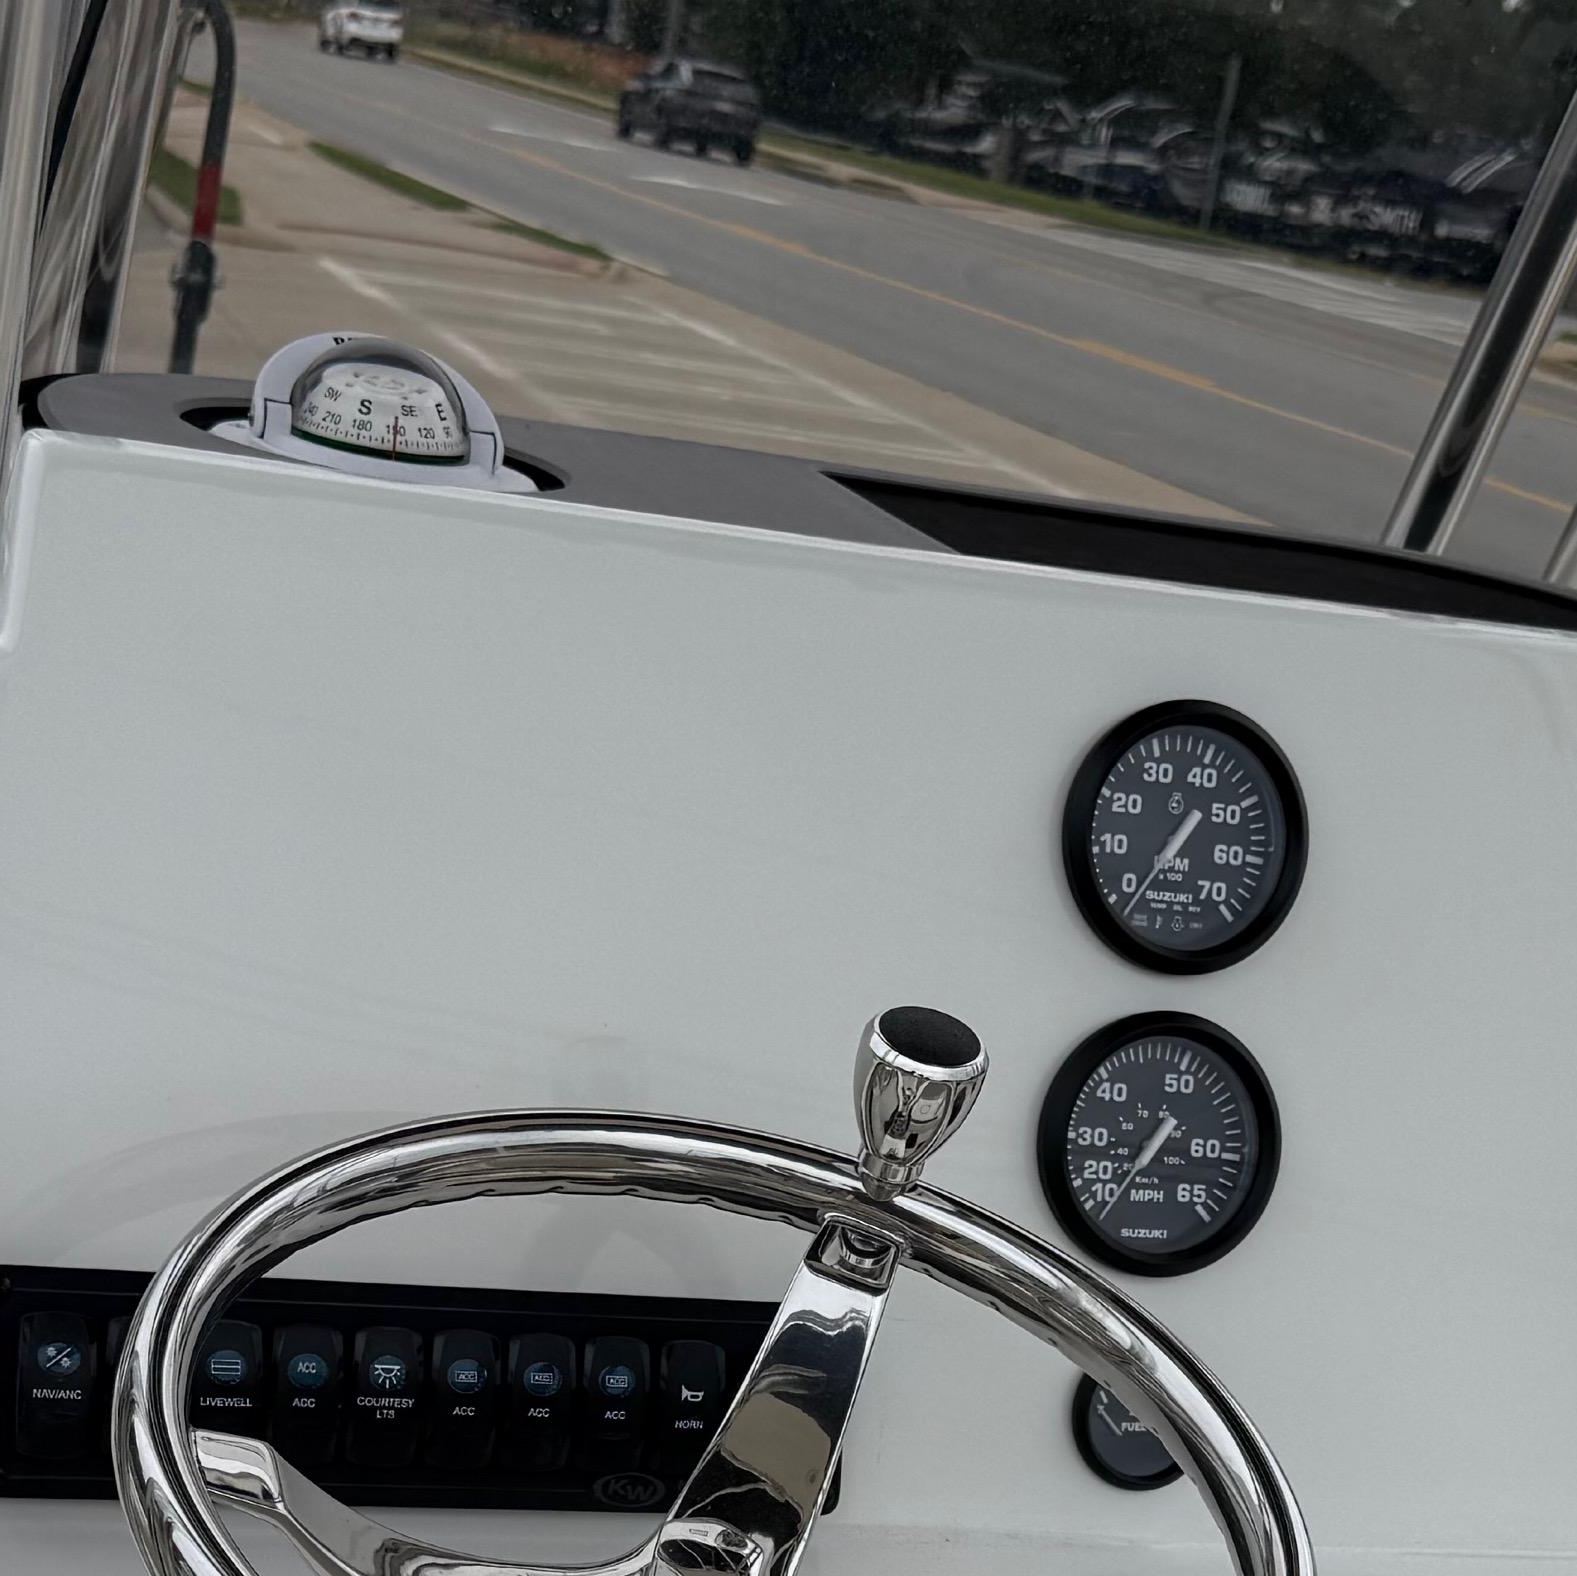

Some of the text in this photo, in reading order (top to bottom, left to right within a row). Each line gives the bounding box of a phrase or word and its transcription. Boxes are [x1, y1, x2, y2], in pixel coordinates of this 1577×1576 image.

[324, 387, 342, 401] SW
[358, 399, 373, 416] S
[401, 405, 418, 418] SE
[435, 403, 447, 422] E
[322, 411, 342, 425] 210
[352, 419, 372, 432] 180
[418, 427, 435, 439] 120
[1143, 761, 1173, 784] 30
[1187, 767, 1217, 788] 40
[1112, 792, 1142, 814] 20
[1211, 803, 1241, 825] 50
[1100, 833, 1128, 854] 10
[1213, 844, 1243, 867] 60
[1122, 873, 1137, 893] 0
[1166, 872, 1183, 882] 100
[1145, 890, 1193, 903] SUZUKI
[1197, 880, 1227, 902] 70
[1164, 1074, 1194, 1094] 50
[1096, 1082, 1127, 1102] 40
[1077, 1127, 1108, 1147] 30
[1191, 1139, 1220, 1158] 60
[1164, 1156, 1180, 1165] 100
[1083, 1161, 1112, 1180] 20
[1091, 1183, 1119, 1201] 10
[1130, 1189, 1164, 1202] MPH
[1177, 1184, 1207, 1203] 65
[1120, 1228, 1167, 1239] SUZUKI
[297, 1362, 317, 1373] ACC
[32, 1388, 82, 1400] NAV/ANC
[200, 1397, 252, 1407] LIVEWELL
[292, 1398, 315, 1408] ACC
[356, 1396, 415, 1408] COURTESY
[376, 1409, 395, 1419] LTS
[452, 1406, 476, 1416] ACC
[528, 1408, 550, 1417] ACC
[604, 1411, 626, 1420] ACC
[675, 1419, 704, 1429] HORN
